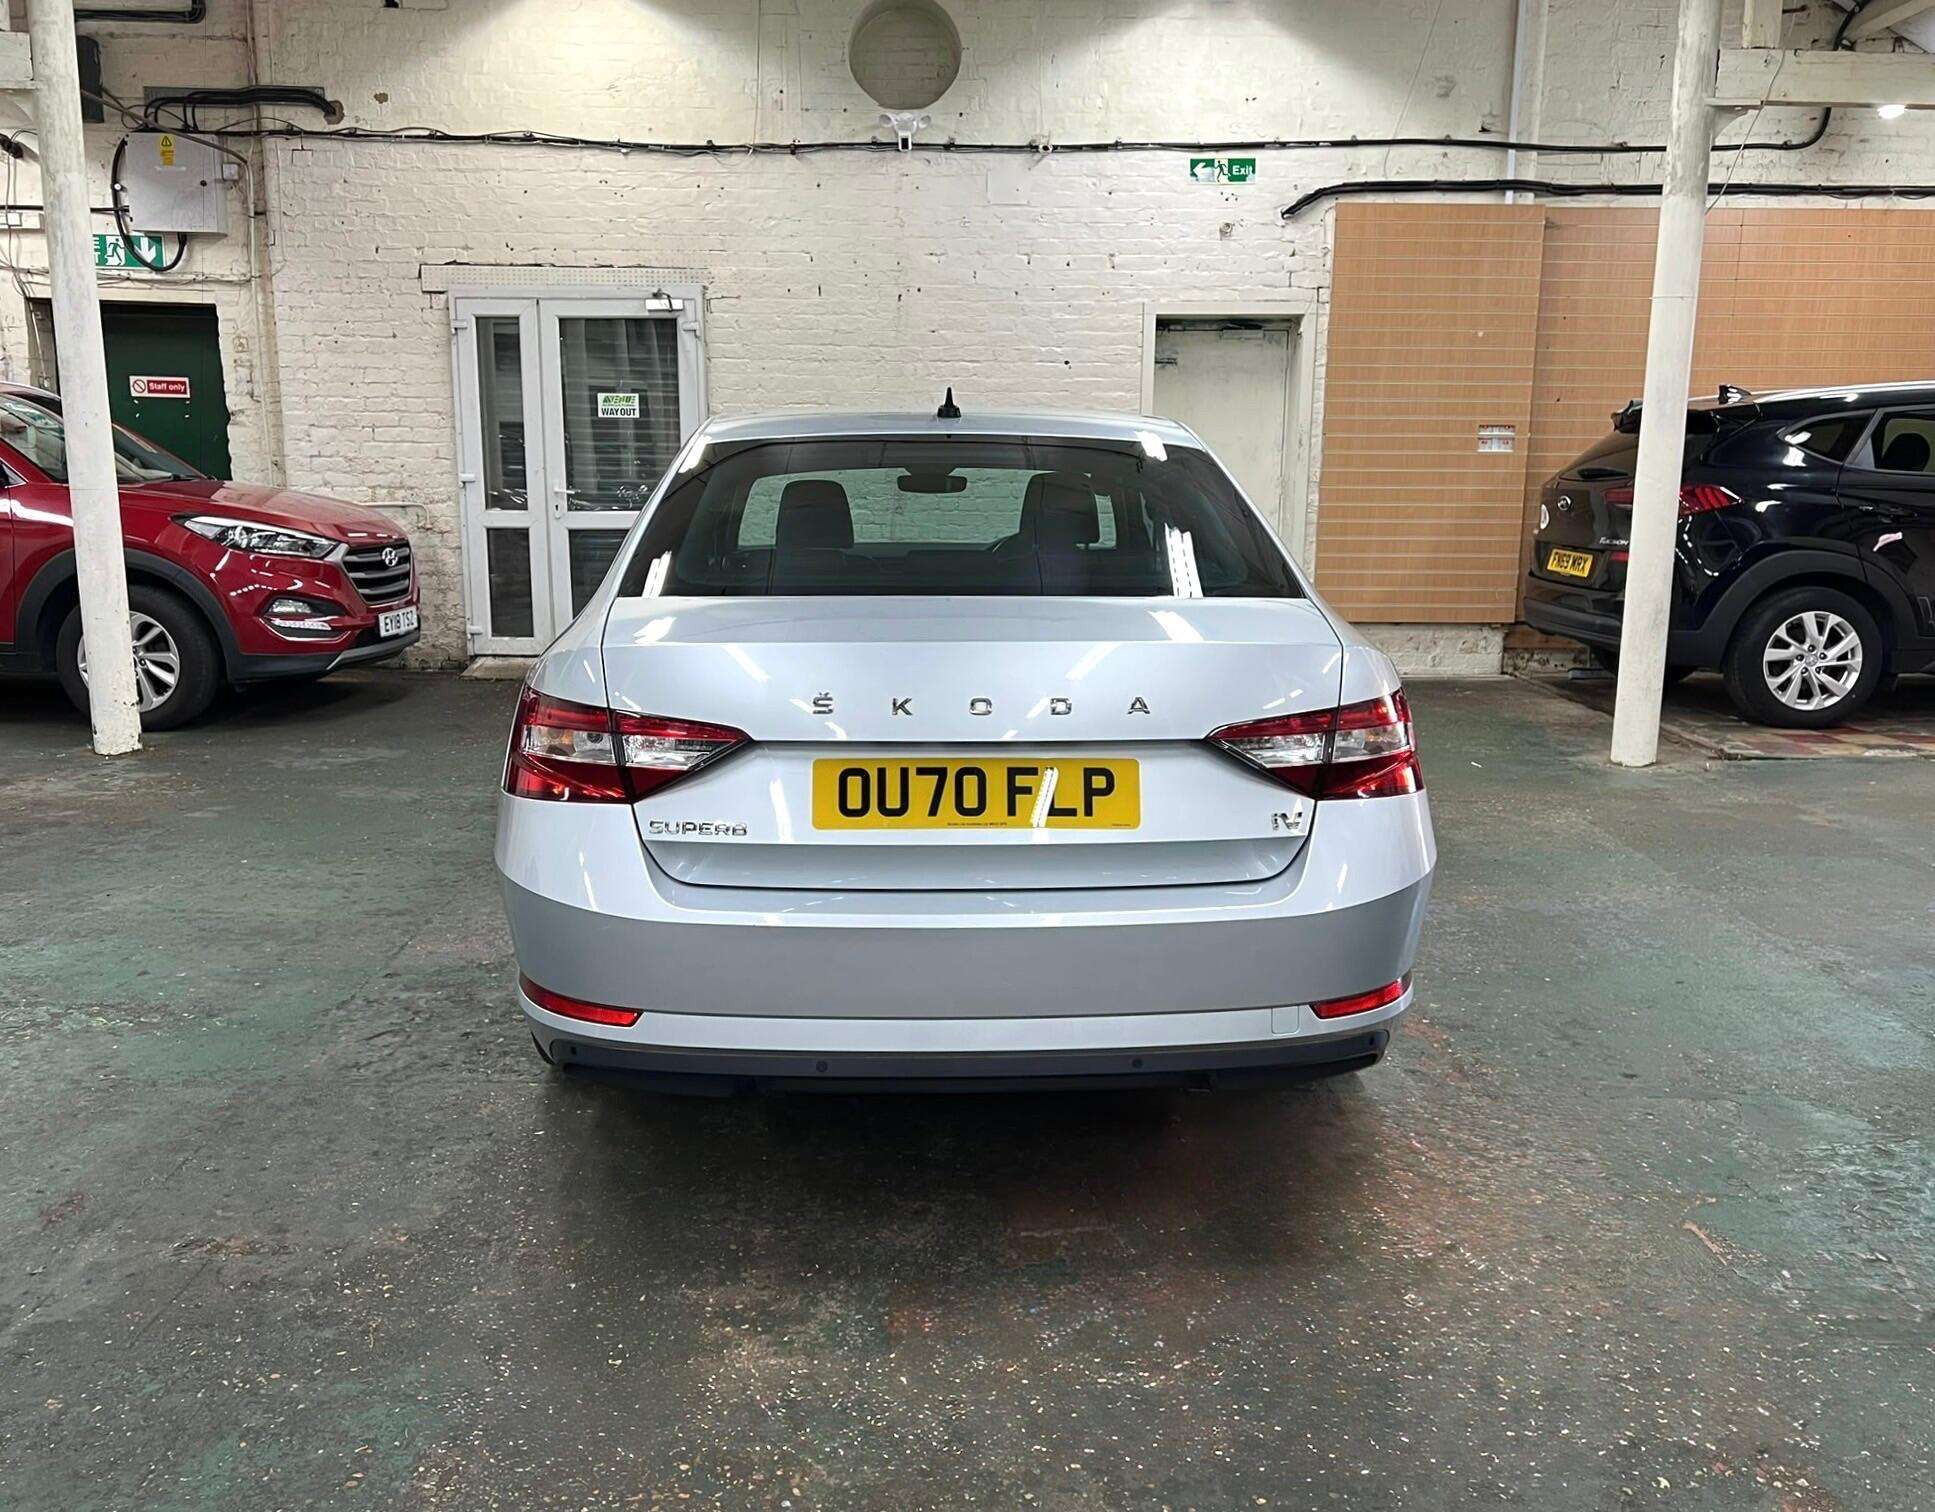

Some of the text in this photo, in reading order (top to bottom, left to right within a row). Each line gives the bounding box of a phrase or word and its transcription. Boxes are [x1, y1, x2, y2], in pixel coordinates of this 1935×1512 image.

[1232, 165, 1253, 176] Exit
[148, 382, 185, 393] Staff only
[601, 407, 637, 416] WAY OUT
[812, 692, 1151, 716] ŠKODA
[838, 767, 987, 818] OU70
[648, 820, 748, 837] SUPERB
